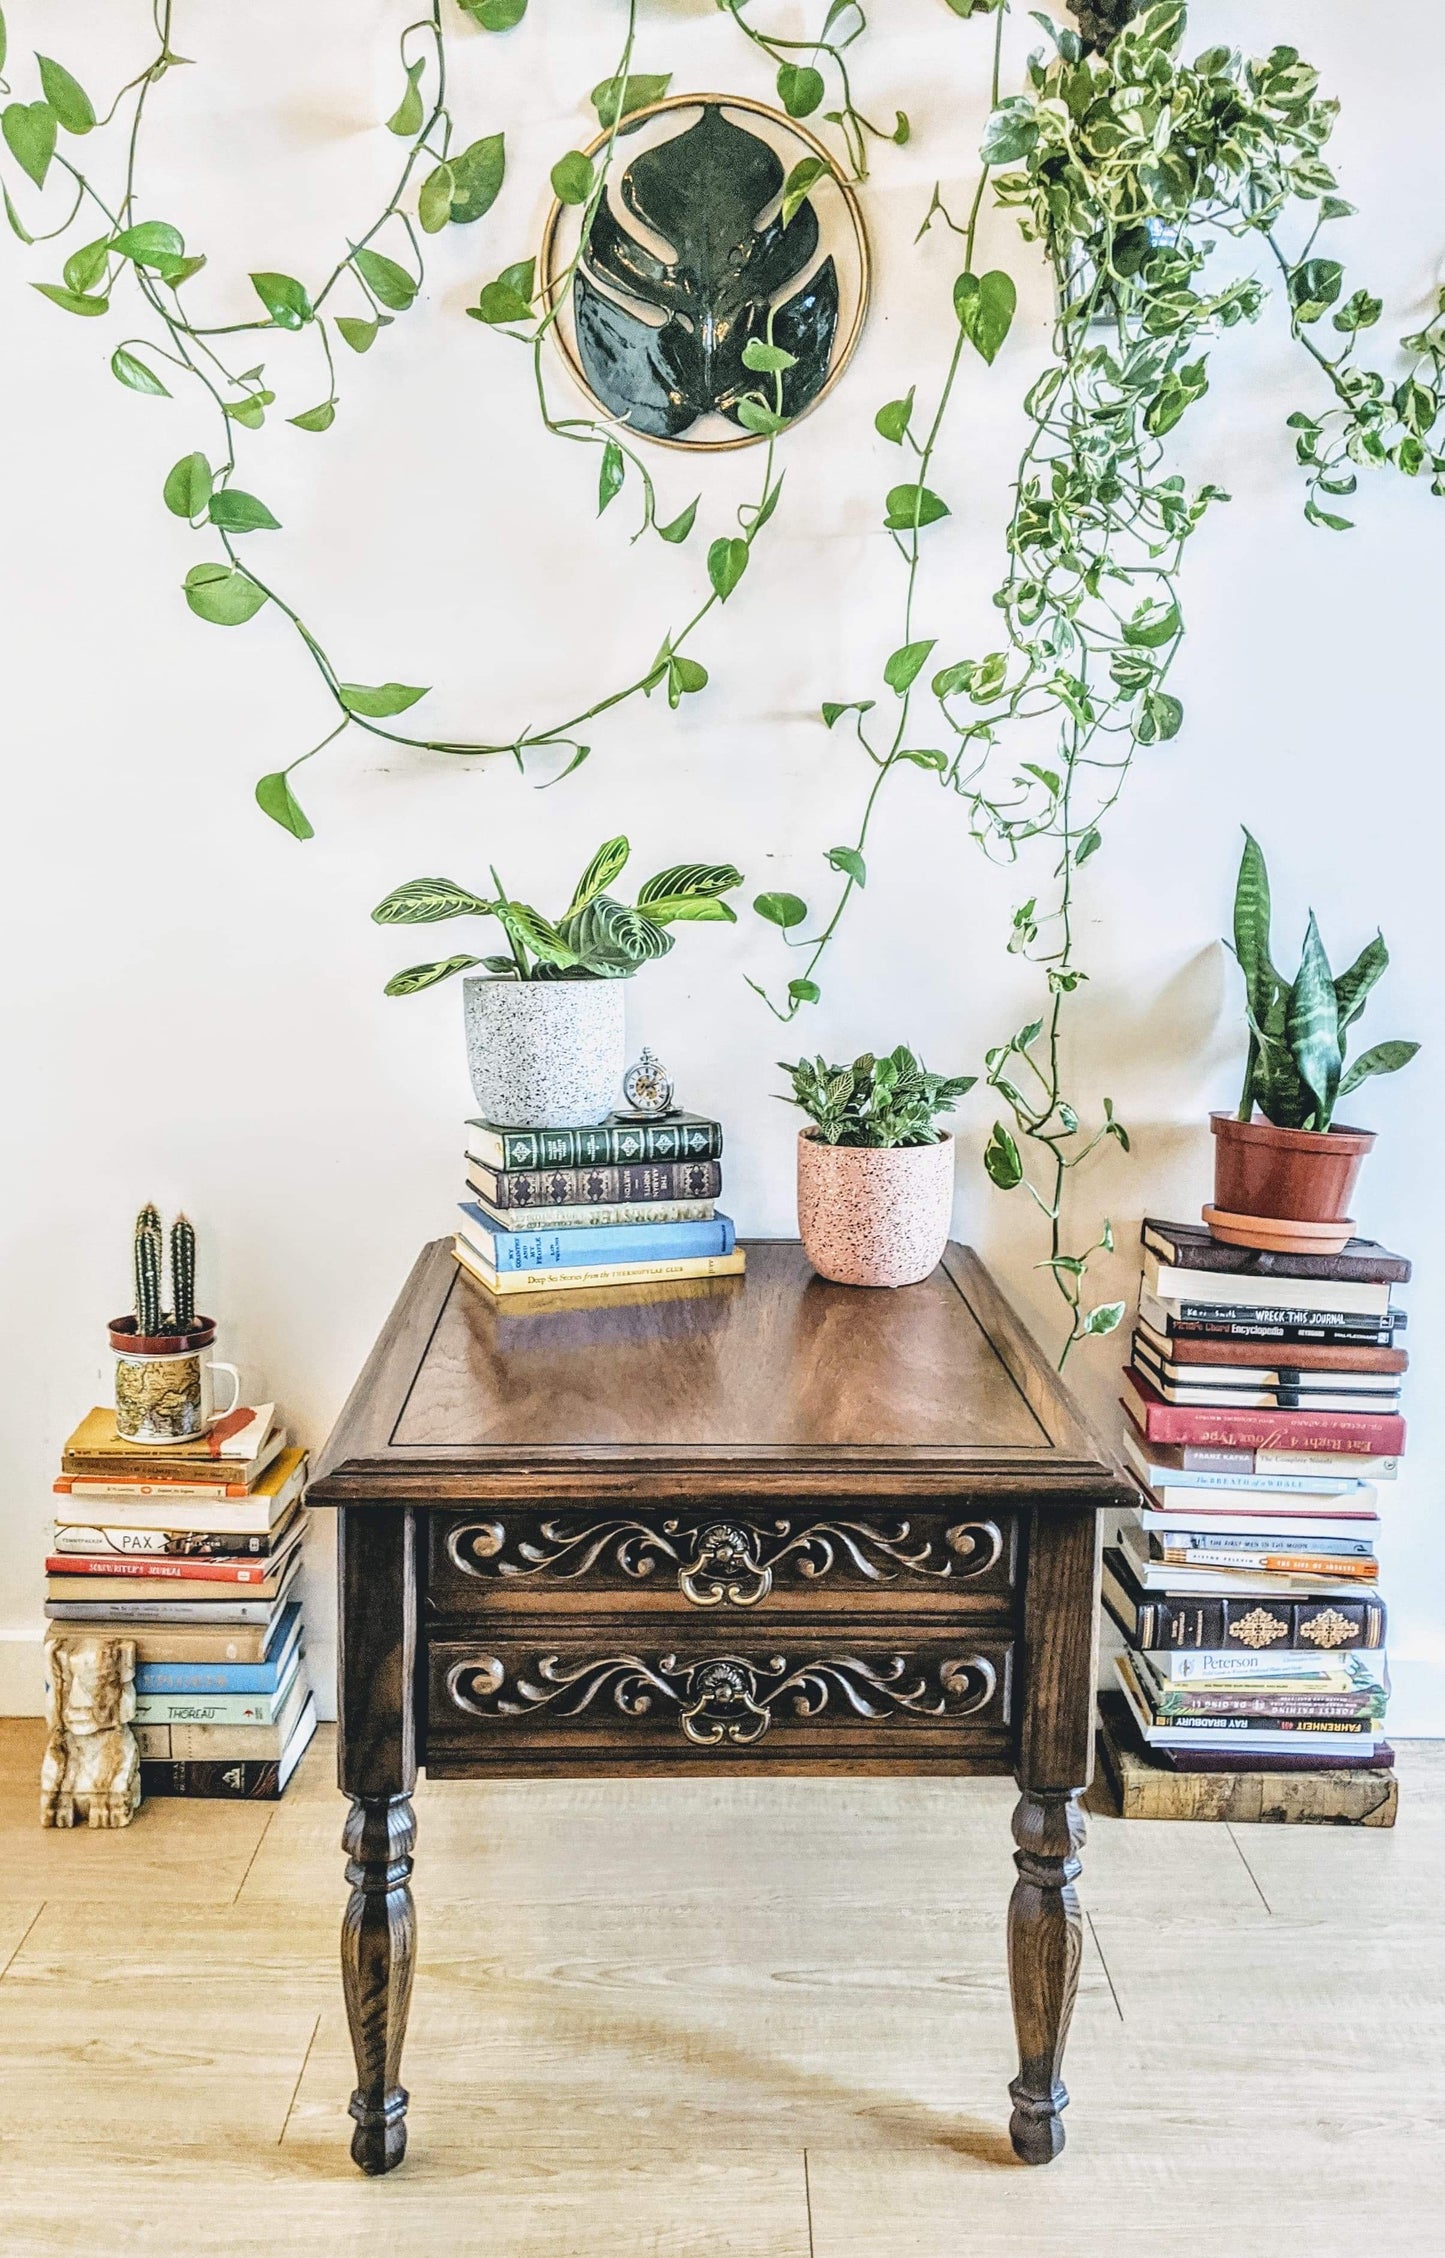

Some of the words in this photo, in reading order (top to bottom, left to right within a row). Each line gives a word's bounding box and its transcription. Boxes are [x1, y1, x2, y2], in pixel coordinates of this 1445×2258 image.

[1255, 1310, 1285, 1322] WRECK
[1287, 1311, 1308, 1323] THIS
[1309, 1313, 1345, 1324] JOURNAL
[1231, 1324, 1284, 1336] Encyclopedia
[1201, 1431, 1237, 1445] Type
[1239, 1429, 1288, 1448] Your
[1291, 1436, 1298, 1447] 4
[1304, 1437, 1342, 1449] Right
[1346, 1439, 1371, 1452] Eat
[1194, 1452, 1221, 1460] FRANZ
[122, 1536, 152, 1548] PAX
[1203, 1655, 1258, 1670] Peterson
[168, 1707, 227, 1719] THOREAU
[1272, 1706, 1314, 1715] BATHING
[1318, 1707, 1354, 1716] FOREST
[1176, 1717, 1227, 1727] BRADBURY
[1228, 1719, 1248, 1728] RAY
[1296, 1722, 1362, 1732] FAHRENHEIT
